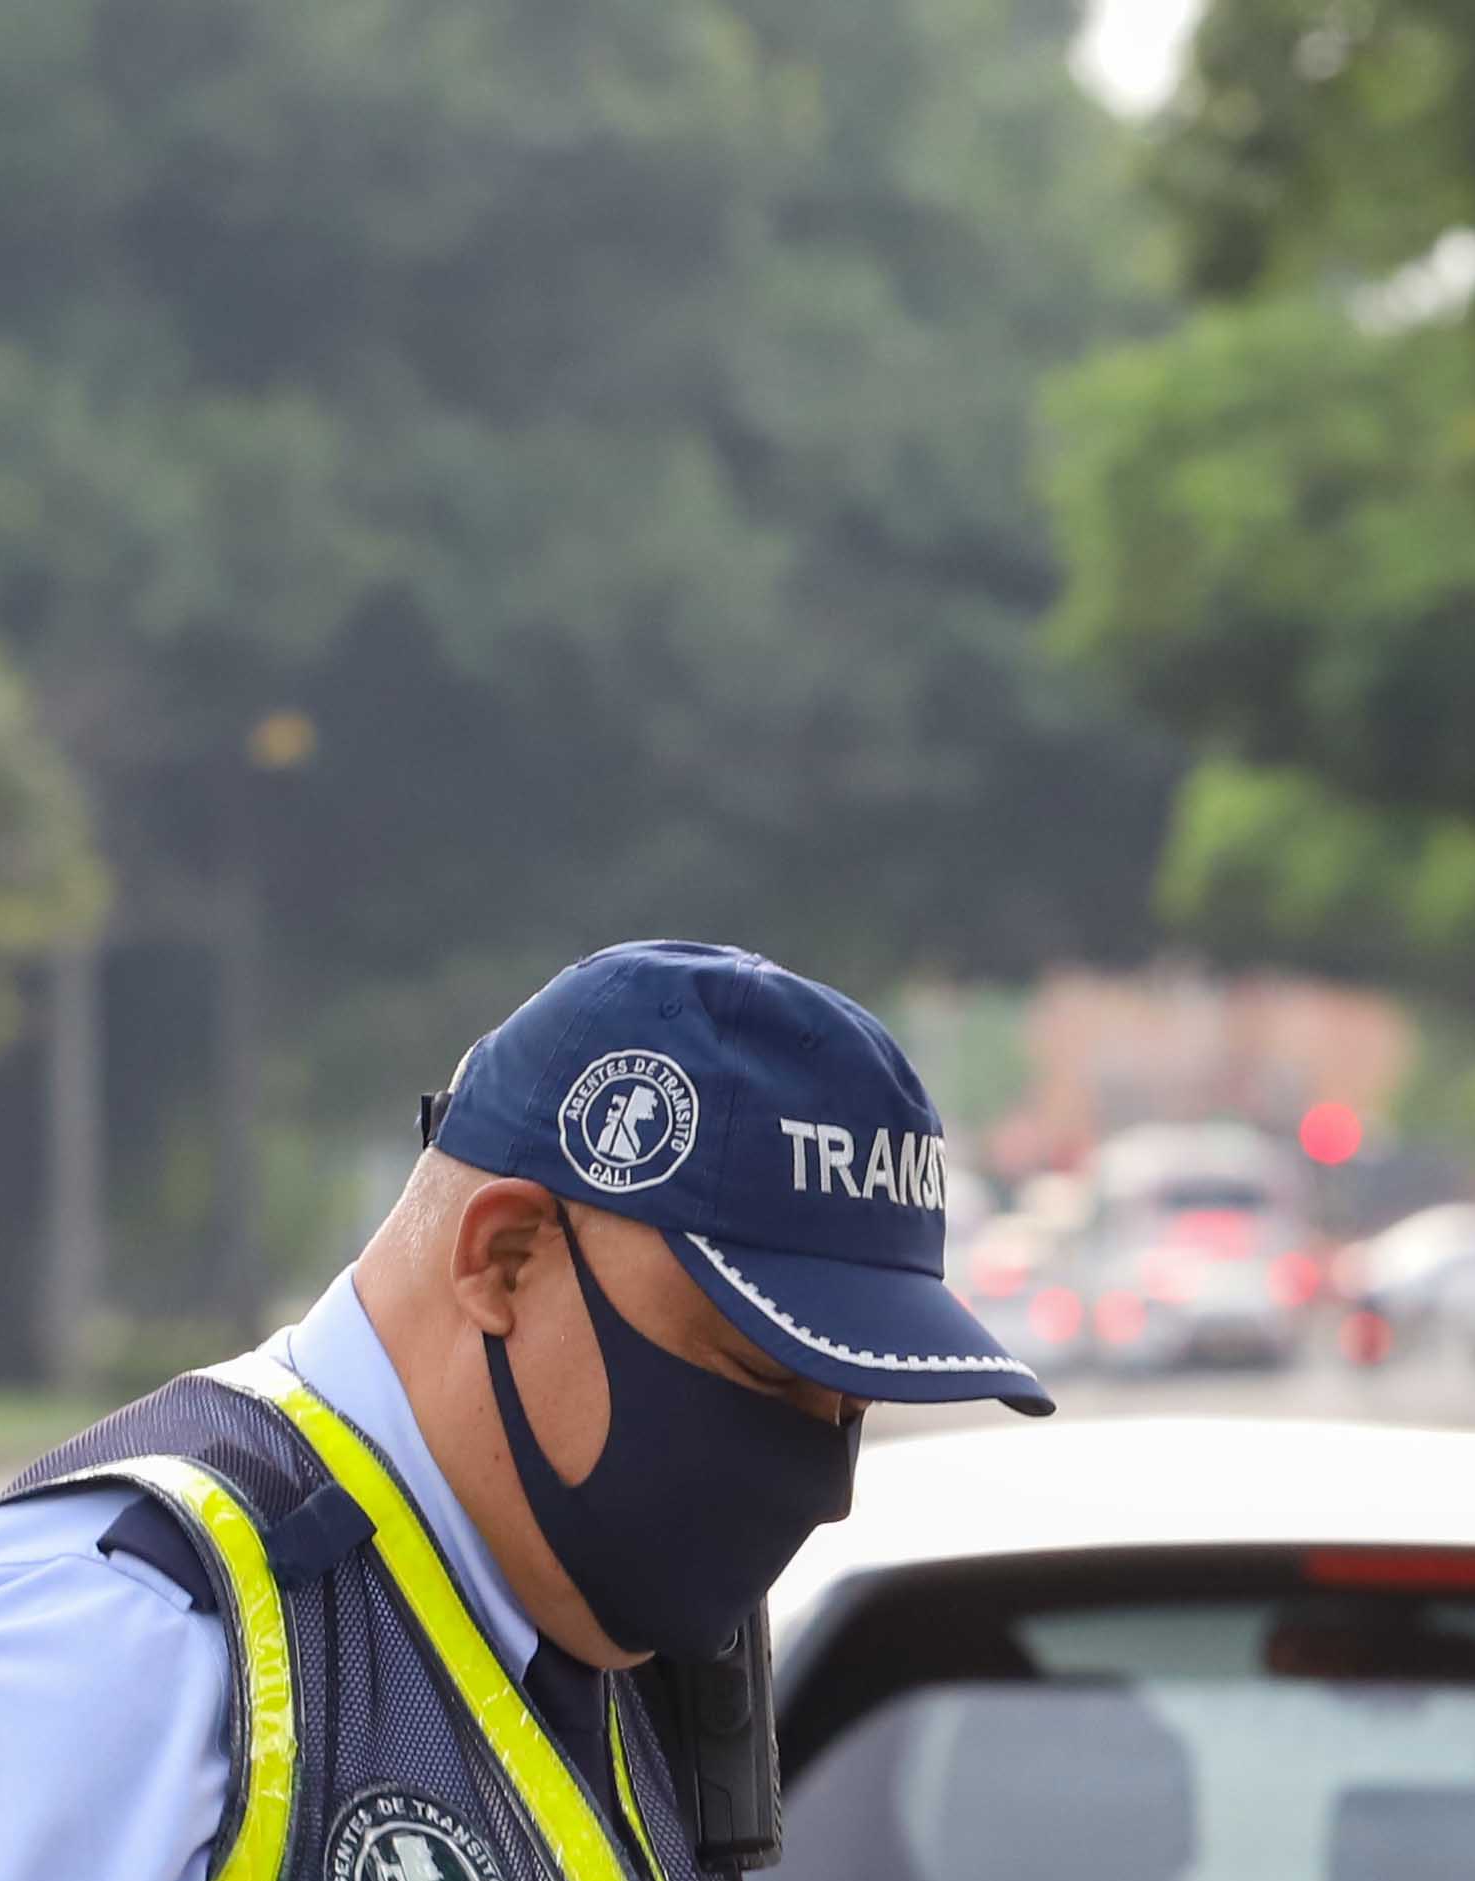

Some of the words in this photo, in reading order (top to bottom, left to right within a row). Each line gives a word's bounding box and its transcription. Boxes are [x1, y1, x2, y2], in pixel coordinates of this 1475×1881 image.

[566, 1059, 627, 1122] AGENTES
[634, 1058, 659, 1076] DE
[657, 1066, 691, 1152] TRANSITO
[589, 1162, 631, 1186] CALI
